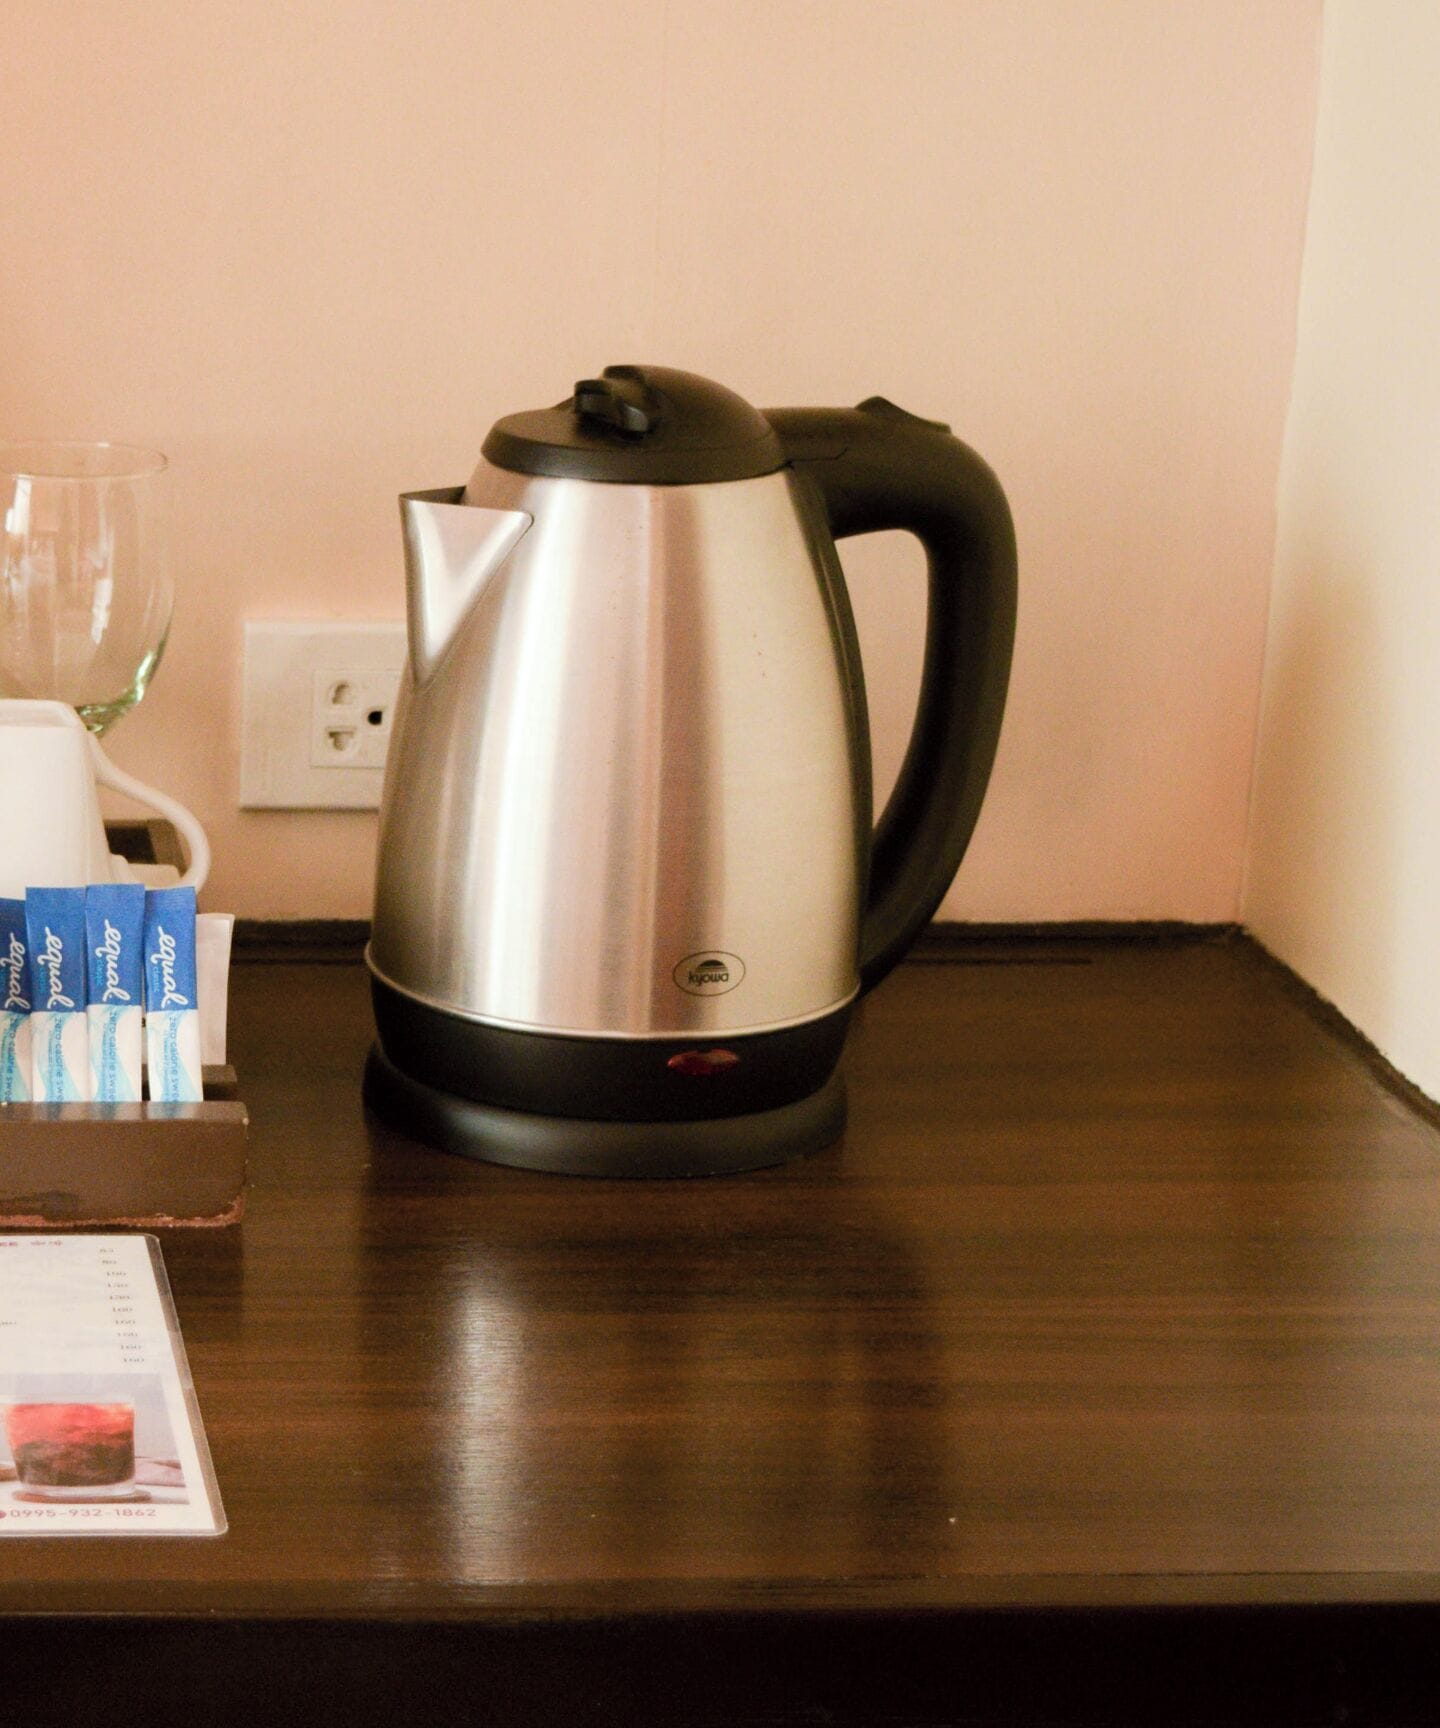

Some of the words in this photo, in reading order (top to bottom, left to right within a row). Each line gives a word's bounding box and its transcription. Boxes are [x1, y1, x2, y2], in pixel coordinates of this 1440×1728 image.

[0, 932, 31, 1009] equal
[37, 926, 75, 1009] equal
[95, 919, 131, 1002] equal
[150, 925, 189, 1009] equal
[152, 966, 160, 993] classic
[688, 970, 729, 986] kyowa
[54, 1017, 64, 1041] zero
[109, 1011, 118, 1033] zero
[169, 1017, 178, 1039] zero
[6, 1040, 17, 1074] calorie
[55, 1042, 66, 1078] calorie
[108, 1036, 118, 1071] calorie
[170, 1041, 180, 1075] calorie
[9, 1508, 158, 1518] 0995-932-1862
